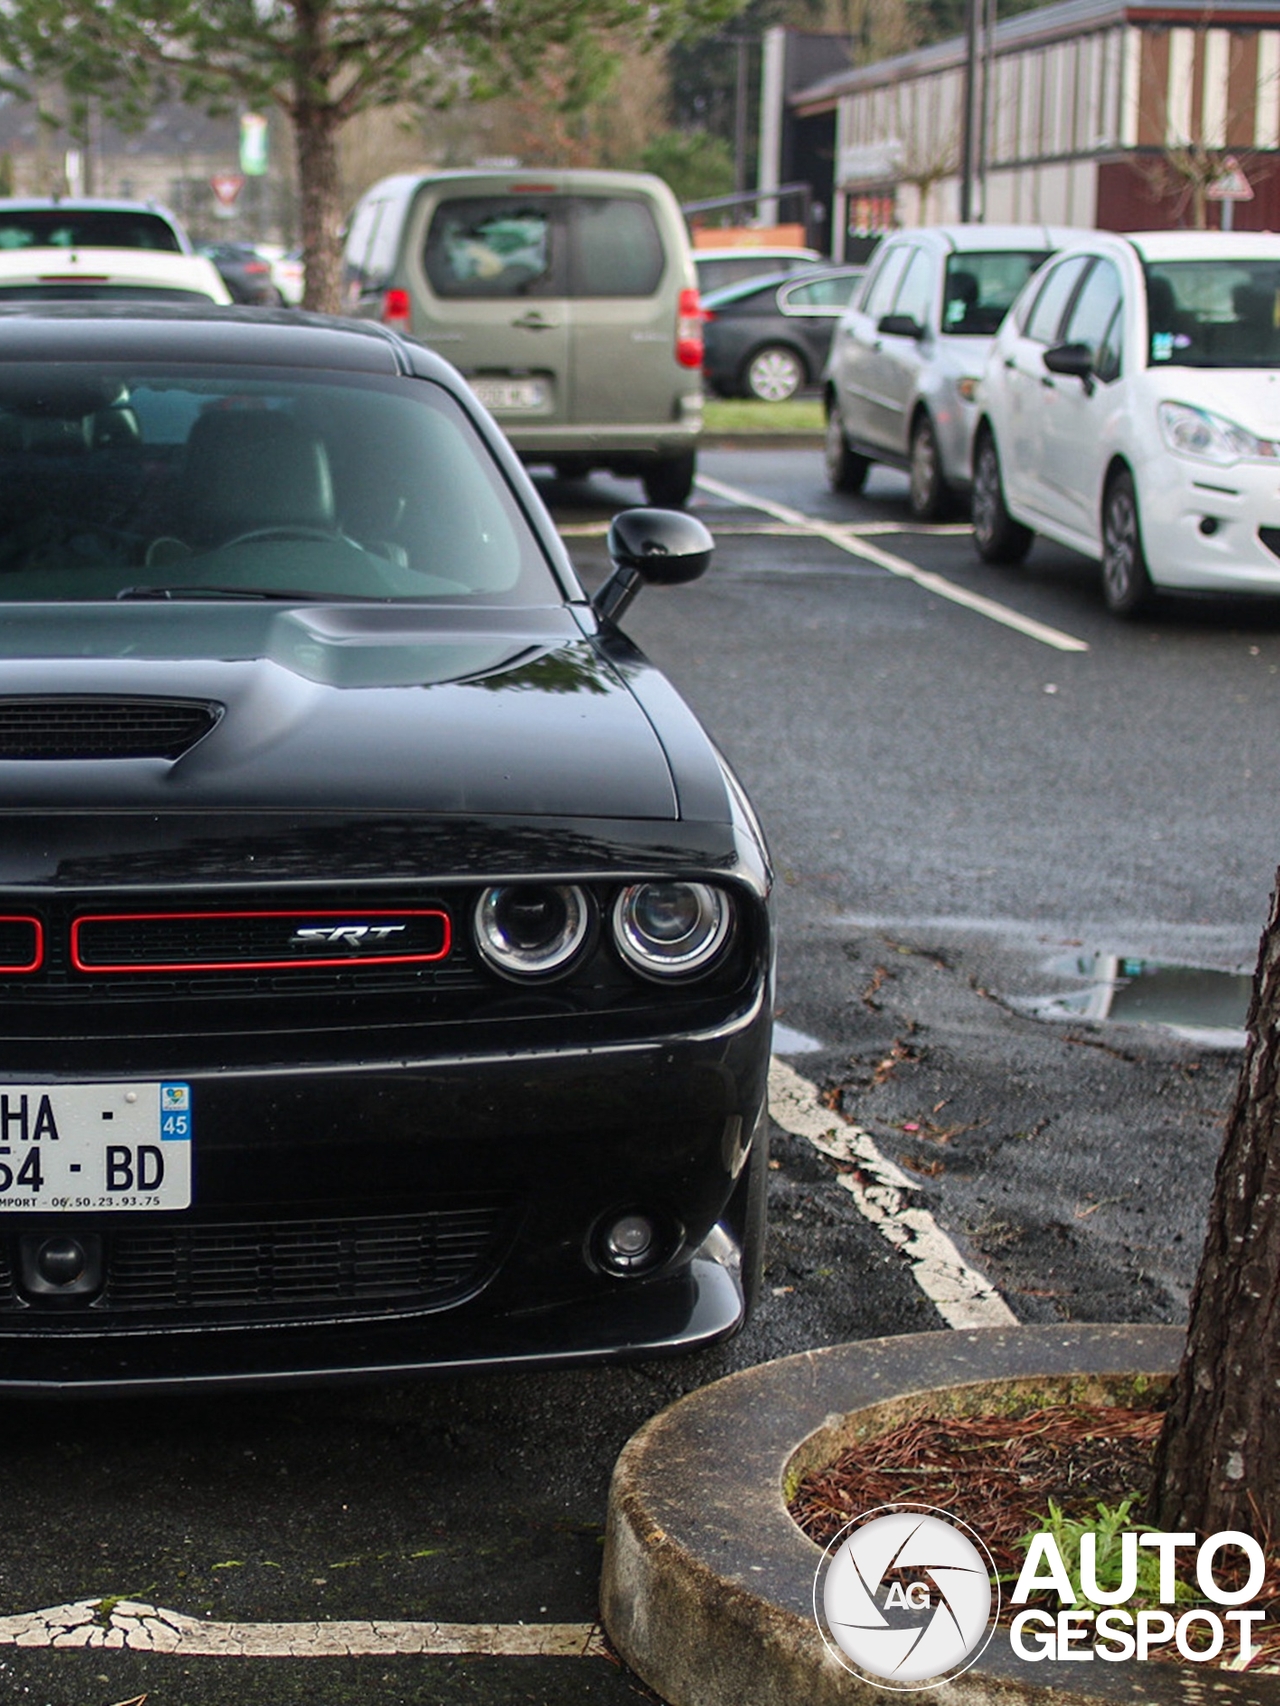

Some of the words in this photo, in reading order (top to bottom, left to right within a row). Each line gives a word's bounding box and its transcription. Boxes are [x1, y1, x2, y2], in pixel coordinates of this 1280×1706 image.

[289, 925, 406, 946] SRT
[0, 1094, 59, 1141] HA
[163, 1116, 187, 1134] 45
[106, 1145, 164, 1191] BD
[51, 1196, 160, 1207] 06.50.23.93.75
